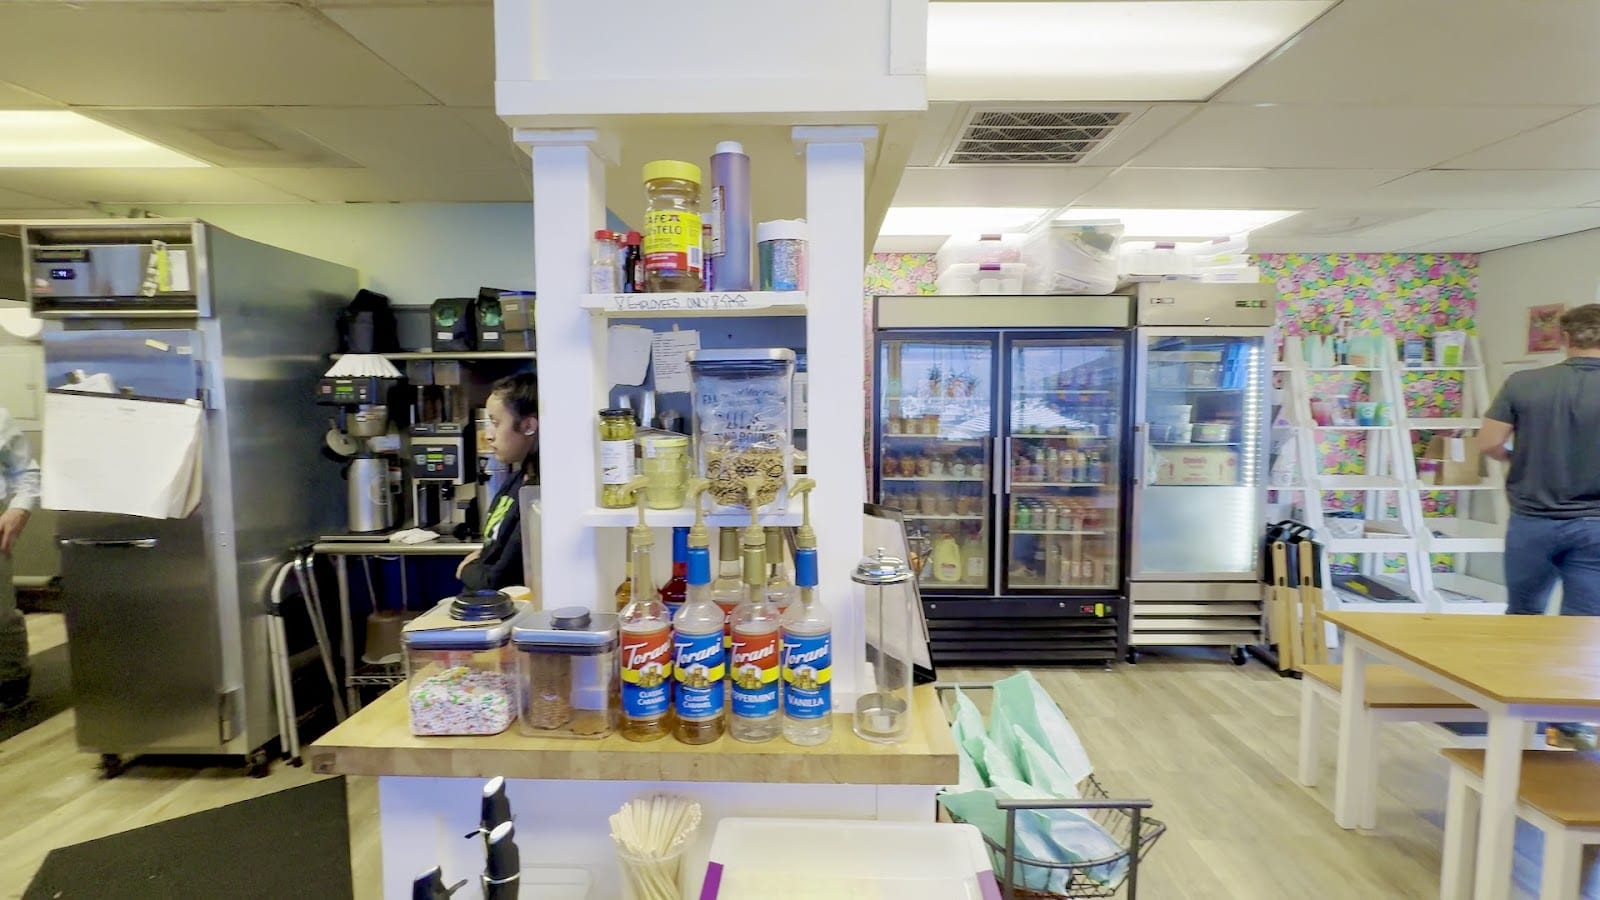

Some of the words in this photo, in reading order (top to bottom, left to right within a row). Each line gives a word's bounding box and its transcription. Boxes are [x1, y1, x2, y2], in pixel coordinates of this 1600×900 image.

[674, 637, 722, 667] Torani
[731, 640, 775, 666] Torani
[783, 640, 829, 667] Torani
[787, 694, 824, 707] VANILLA
